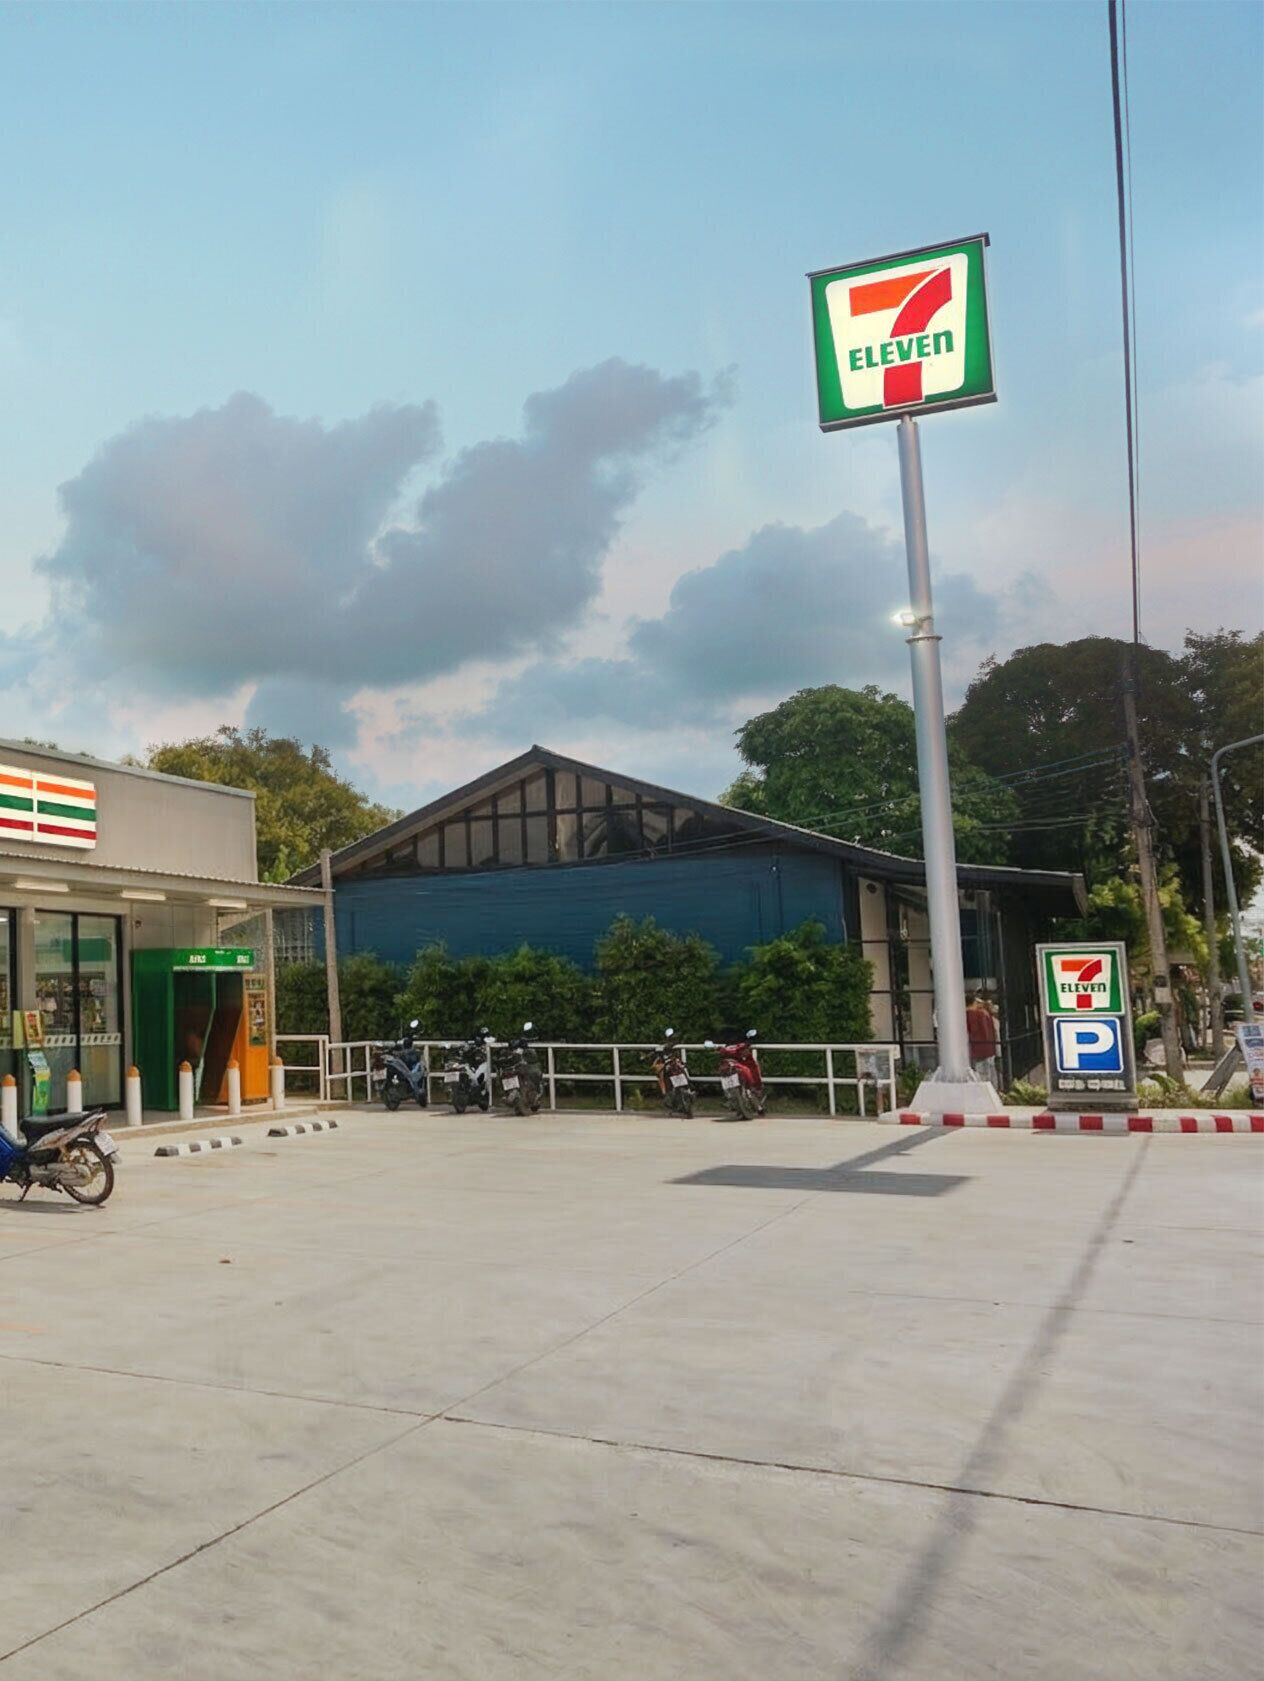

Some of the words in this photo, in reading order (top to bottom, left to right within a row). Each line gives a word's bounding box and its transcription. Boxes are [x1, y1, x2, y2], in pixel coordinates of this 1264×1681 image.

[849, 267, 952, 407] 7
[1060, 958, 1103, 1009] 7
[1060, 1021, 1114, 1069] P
